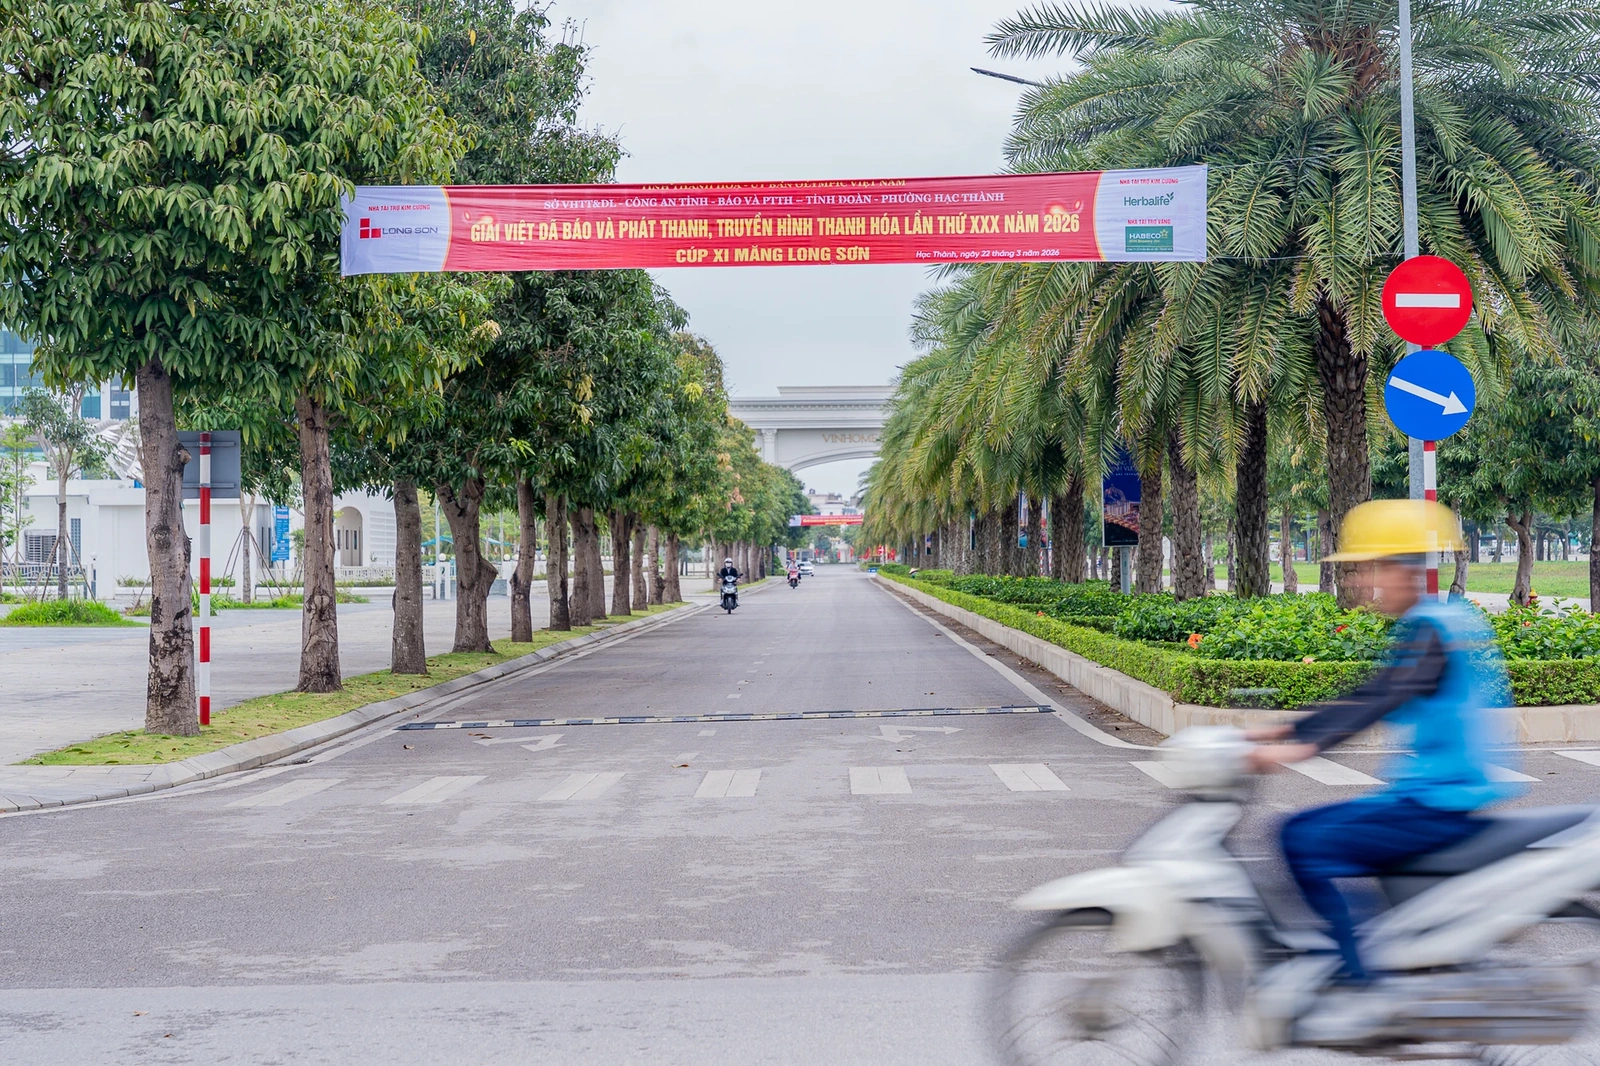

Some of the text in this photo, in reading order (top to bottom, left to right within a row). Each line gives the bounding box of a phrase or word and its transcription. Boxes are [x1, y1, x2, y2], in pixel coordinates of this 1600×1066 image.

[544, 198, 560, 210] SỞ
[561, 199, 616, 209] VHTT&DL
[625, 196, 657, 208] CÔNG
[660, 197, 677, 207] AN
[678, 195, 709, 206] TỈNH
[717, 195, 742, 206] BÁO
[744, 194, 760, 206] VÀ
[763, 196, 793, 205] PTTH
[805, 193, 836, 205] TỈNH
[838, 193, 872, 205] ĐOÀN
[881, 192, 932, 204] PHƯỜNG
[934, 194, 960, 205] HẠC
[961, 190, 1005, 202] THÀNH
[1123, 195, 1170, 206] Herbalife
[382, 227, 413, 235] LONG
[504, 219, 535, 245] VIỆT
[538, 218, 558, 241] DÃ
[562, 217, 592, 240] BÁO
[596, 216, 615, 240] VÀ
[618, 216, 656, 240] PHÁT
[660, 219, 713, 240] THANH,
[716, 212, 773, 237] TRUYỀN
[777, 214, 813, 236] HÌNH
[817, 217, 866, 236] THANH
[870, 213, 900, 235] HÓA
[904, 210, 933, 235] LẦN
[937, 211, 967, 235] THỨ
[969, 214, 1000, 234] XXX
[1004, 210, 1039, 234] NĂM
[1043, 213, 1080, 233] 2026
[675, 245, 870, 263] CÚP XI MĂNG LONG SƠN
[915, 250, 931, 260] Hạc
[932, 250, 958, 259] Thành,
[960, 250, 980, 259] ngày
[991, 249, 1015, 259] tháng
[1016, 249, 1021, 257] 3
[821, 433, 879, 444] VINHOME
